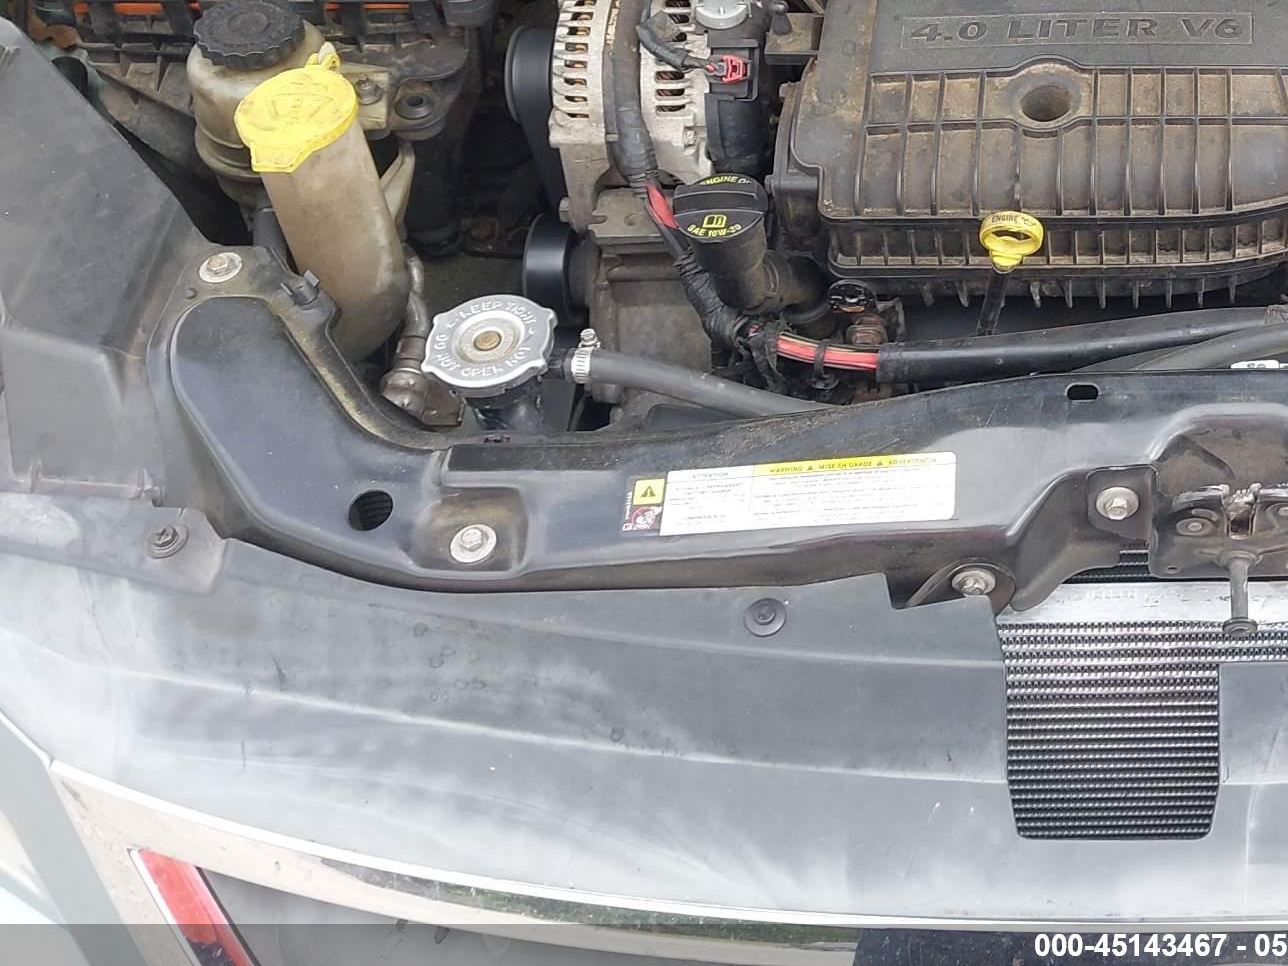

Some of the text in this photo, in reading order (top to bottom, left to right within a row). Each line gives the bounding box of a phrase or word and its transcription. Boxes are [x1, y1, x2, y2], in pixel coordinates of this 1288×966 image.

[909, 17, 1245, 43] 4.0 LITER V6
[458, 300, 503, 319] KEEP
[460, 364, 504, 377] OPEN
